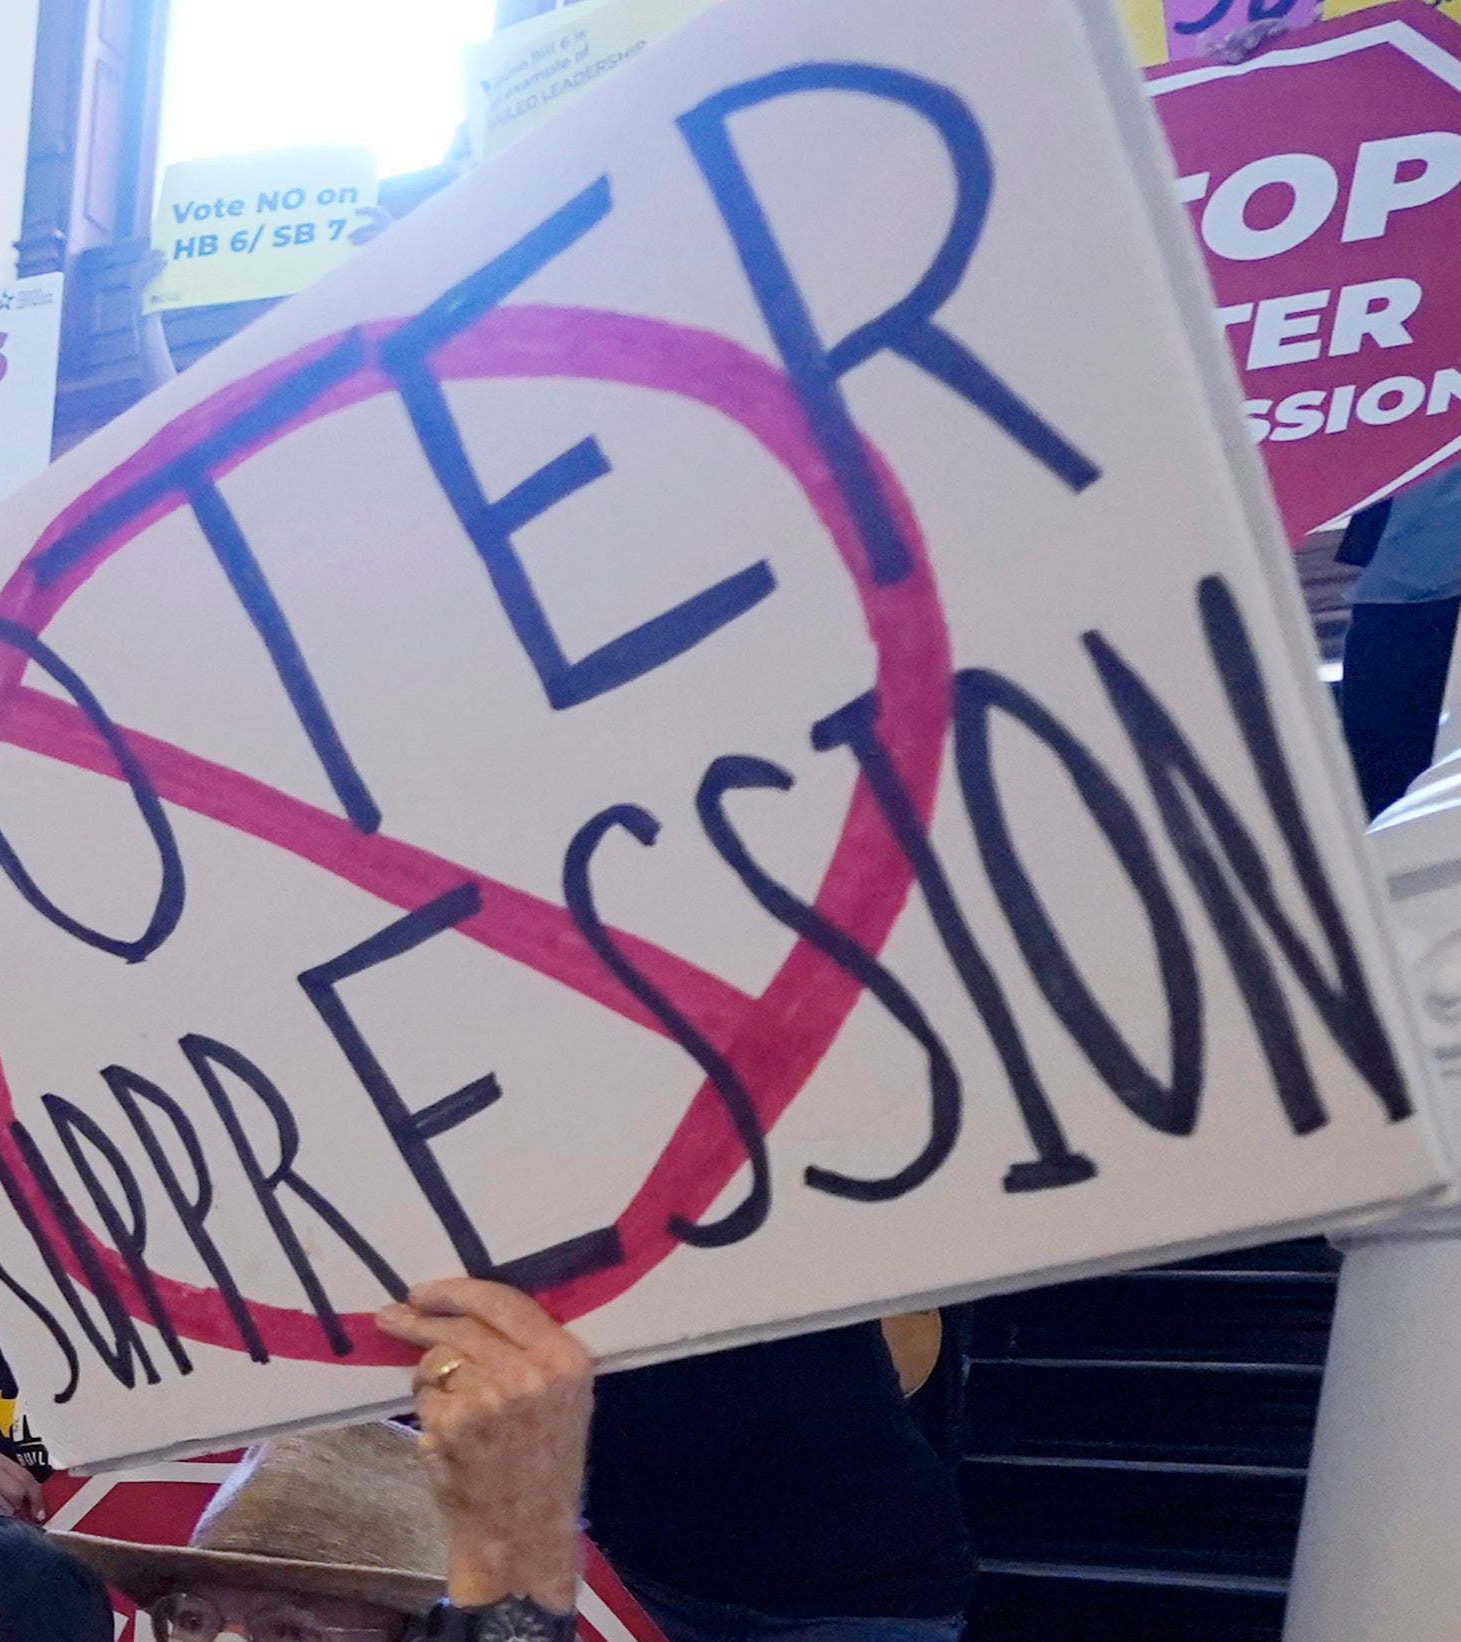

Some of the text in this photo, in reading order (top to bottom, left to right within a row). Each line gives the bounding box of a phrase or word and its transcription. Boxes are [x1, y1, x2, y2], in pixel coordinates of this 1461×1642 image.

[172, 187, 358, 224] Vote NO on
[173, 219, 347, 260] HB 6/ SB 7
